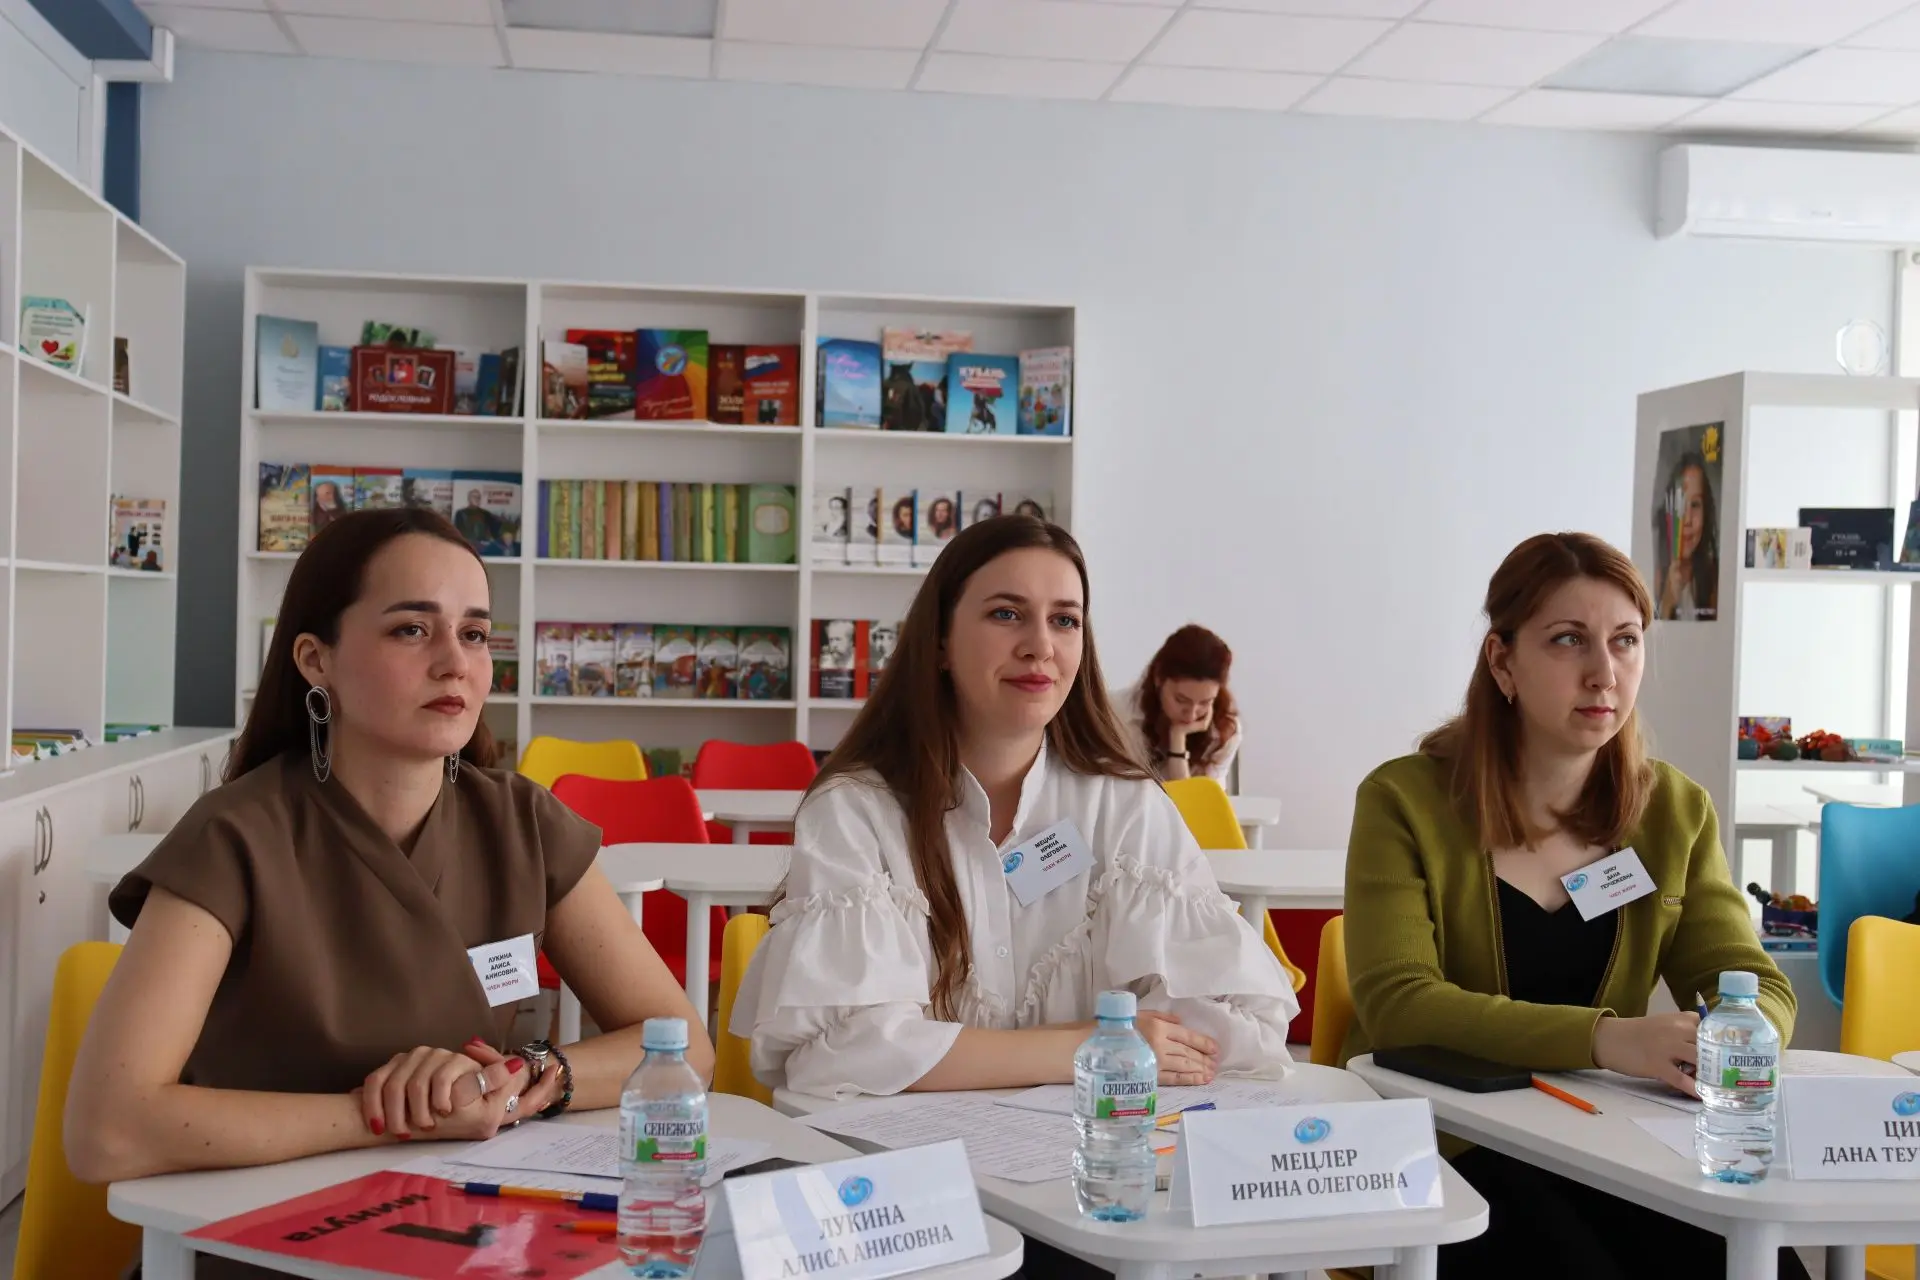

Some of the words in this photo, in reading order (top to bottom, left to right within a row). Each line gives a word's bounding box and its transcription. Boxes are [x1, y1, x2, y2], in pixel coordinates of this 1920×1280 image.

[1034, 832, 1057, 849] МЕЦЛЕР
[1040, 840, 1060, 854] ИРИНА
[1039, 843, 1068, 862] ОЛЕГОВНА
[1042, 862, 1055, 872] ЧЛЕН
[1055, 852, 1072, 865] ЖЮРИ
[1606, 871, 1621, 881] ДАНА
[488, 951, 513, 963] ЛУКИНА
[490, 961, 511, 971] АЛИСА
[485, 967, 518, 981] АНИСОВНА
[486, 983, 501, 991] ЧЛЕН
[502, 978, 519, 988] ЖЮРИ
[1883, 1120, 1920, 1141] ЦИ
[1270, 1149, 1358, 1173] МЕЦЛЕР
[1822, 1146, 1879, 1166] ДАНА
[1881, 1146, 1920, 1163] ТЕУ
[1231, 1179, 1303, 1201] ИРИНА
[1306, 1172, 1409, 1196] ОЛЕГОВНА
[818, 1203, 906, 1241] ЛУКИНА
[781, 1246, 850, 1279] АЛИСА
[853, 1223, 955, 1264] АНИСОВНА
